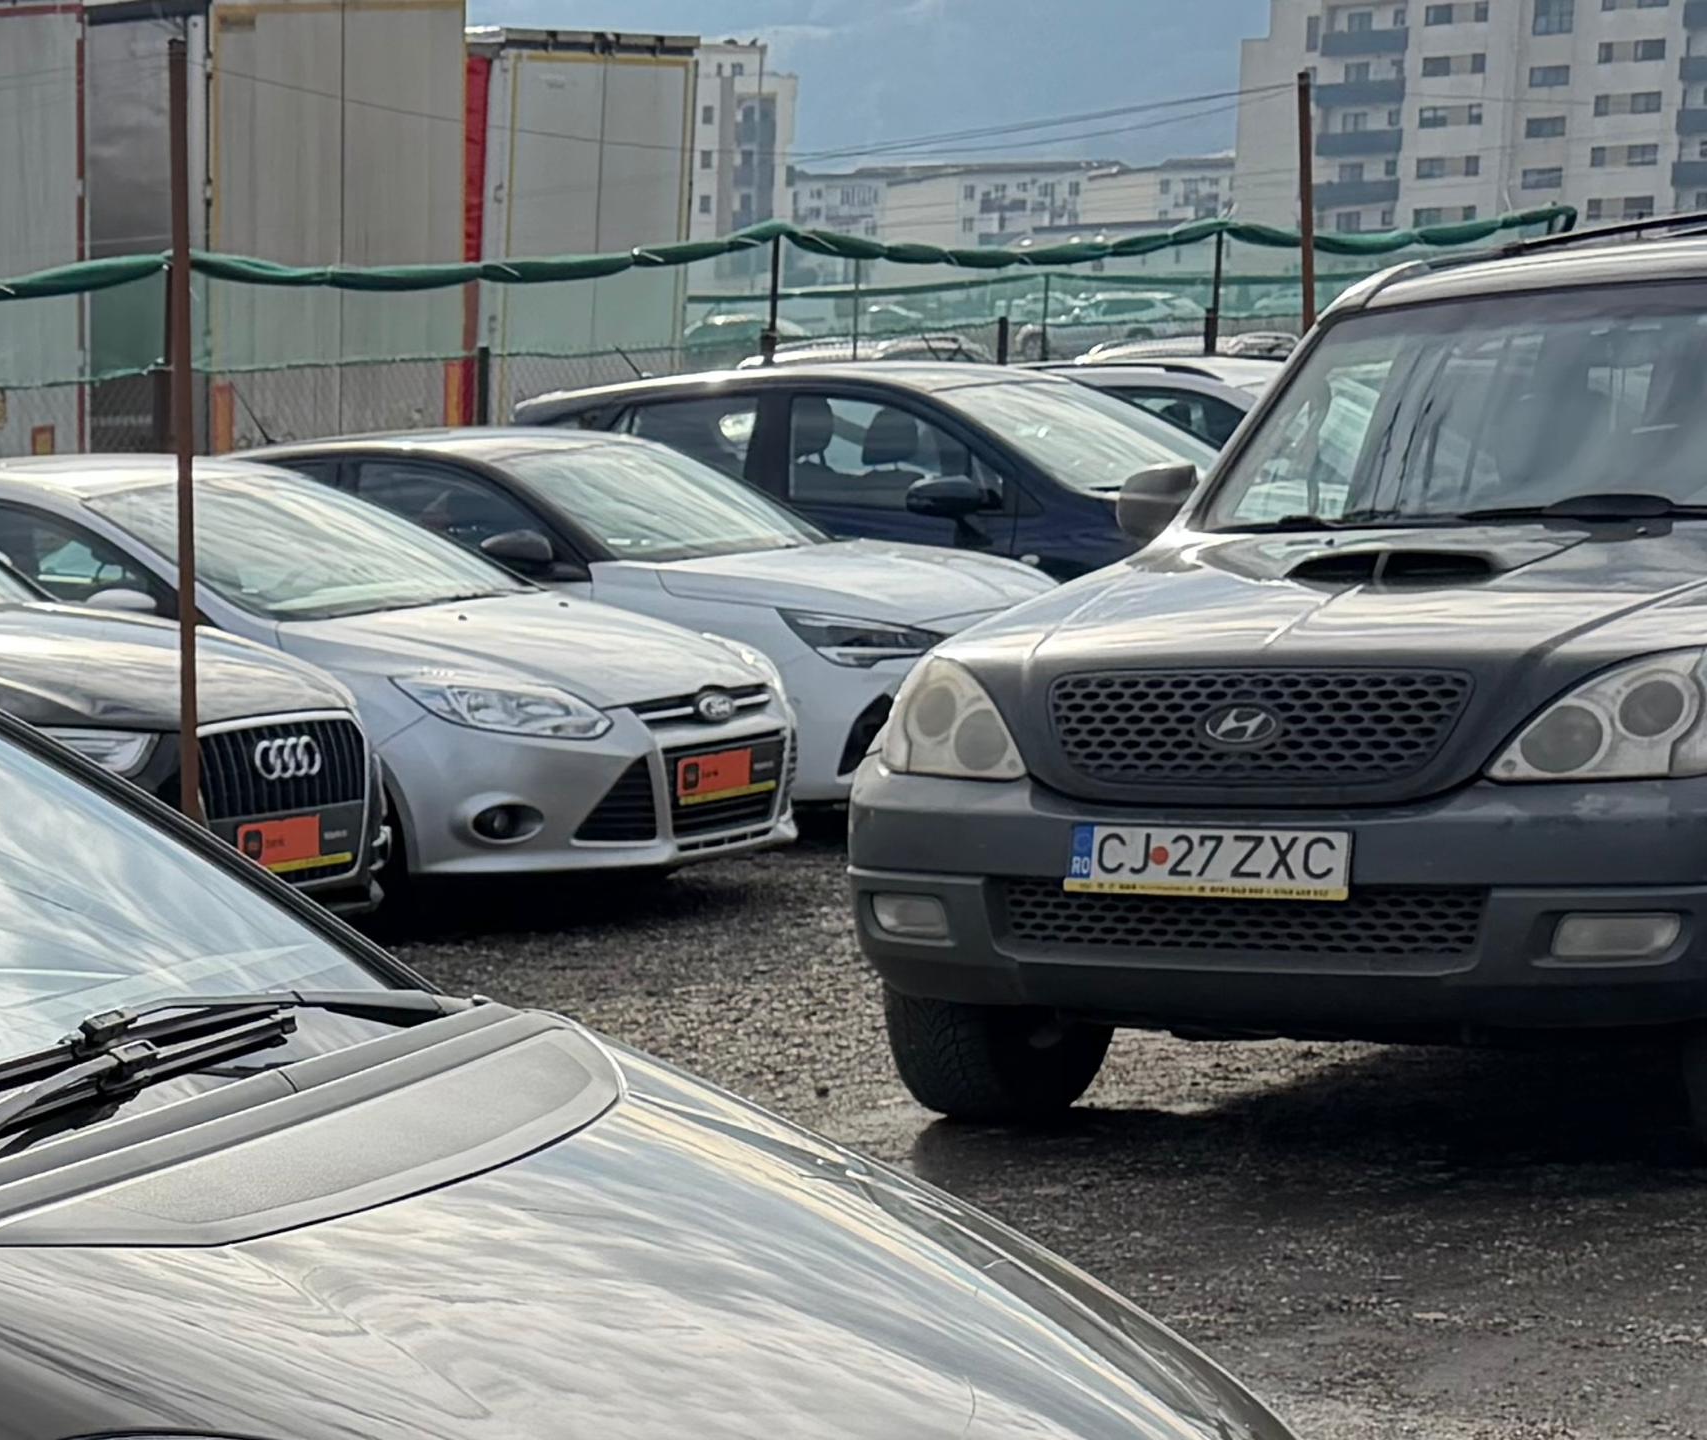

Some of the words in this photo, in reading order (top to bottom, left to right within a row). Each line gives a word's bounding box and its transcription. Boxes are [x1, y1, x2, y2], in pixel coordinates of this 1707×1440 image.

[1071, 855, 1090, 875] RO
[1097, 833, 1151, 875] CJ
[1168, 834, 1225, 878] 27
[1230, 834, 1337, 881] ZXC
